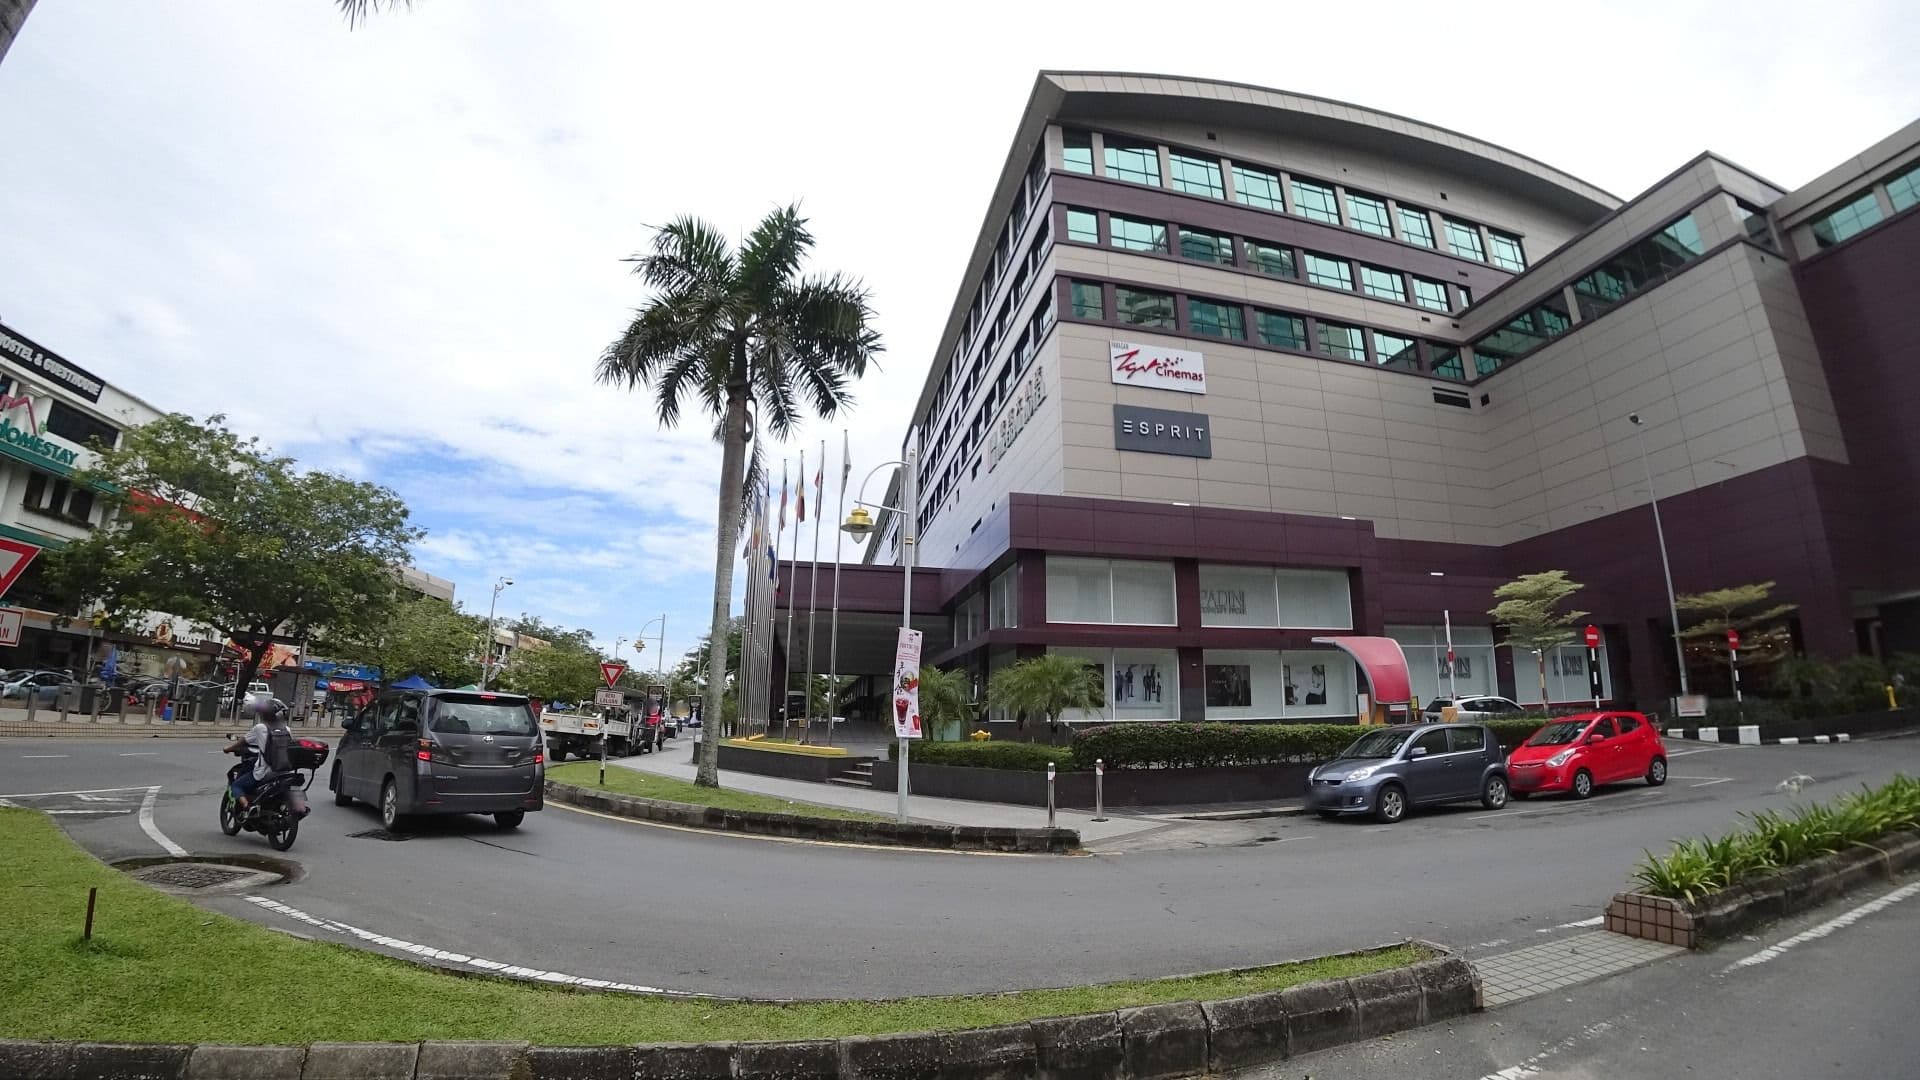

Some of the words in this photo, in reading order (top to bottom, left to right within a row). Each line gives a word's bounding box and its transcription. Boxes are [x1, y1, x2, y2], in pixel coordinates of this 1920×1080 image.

[34, 353, 43, 367] &
[43, 358, 101, 395] GUESTHOUSE
[1156, 366, 1203, 382] Cinemas
[1123, 420, 1204, 440] ESPRIT
[176, 635, 200, 646] TOAST
